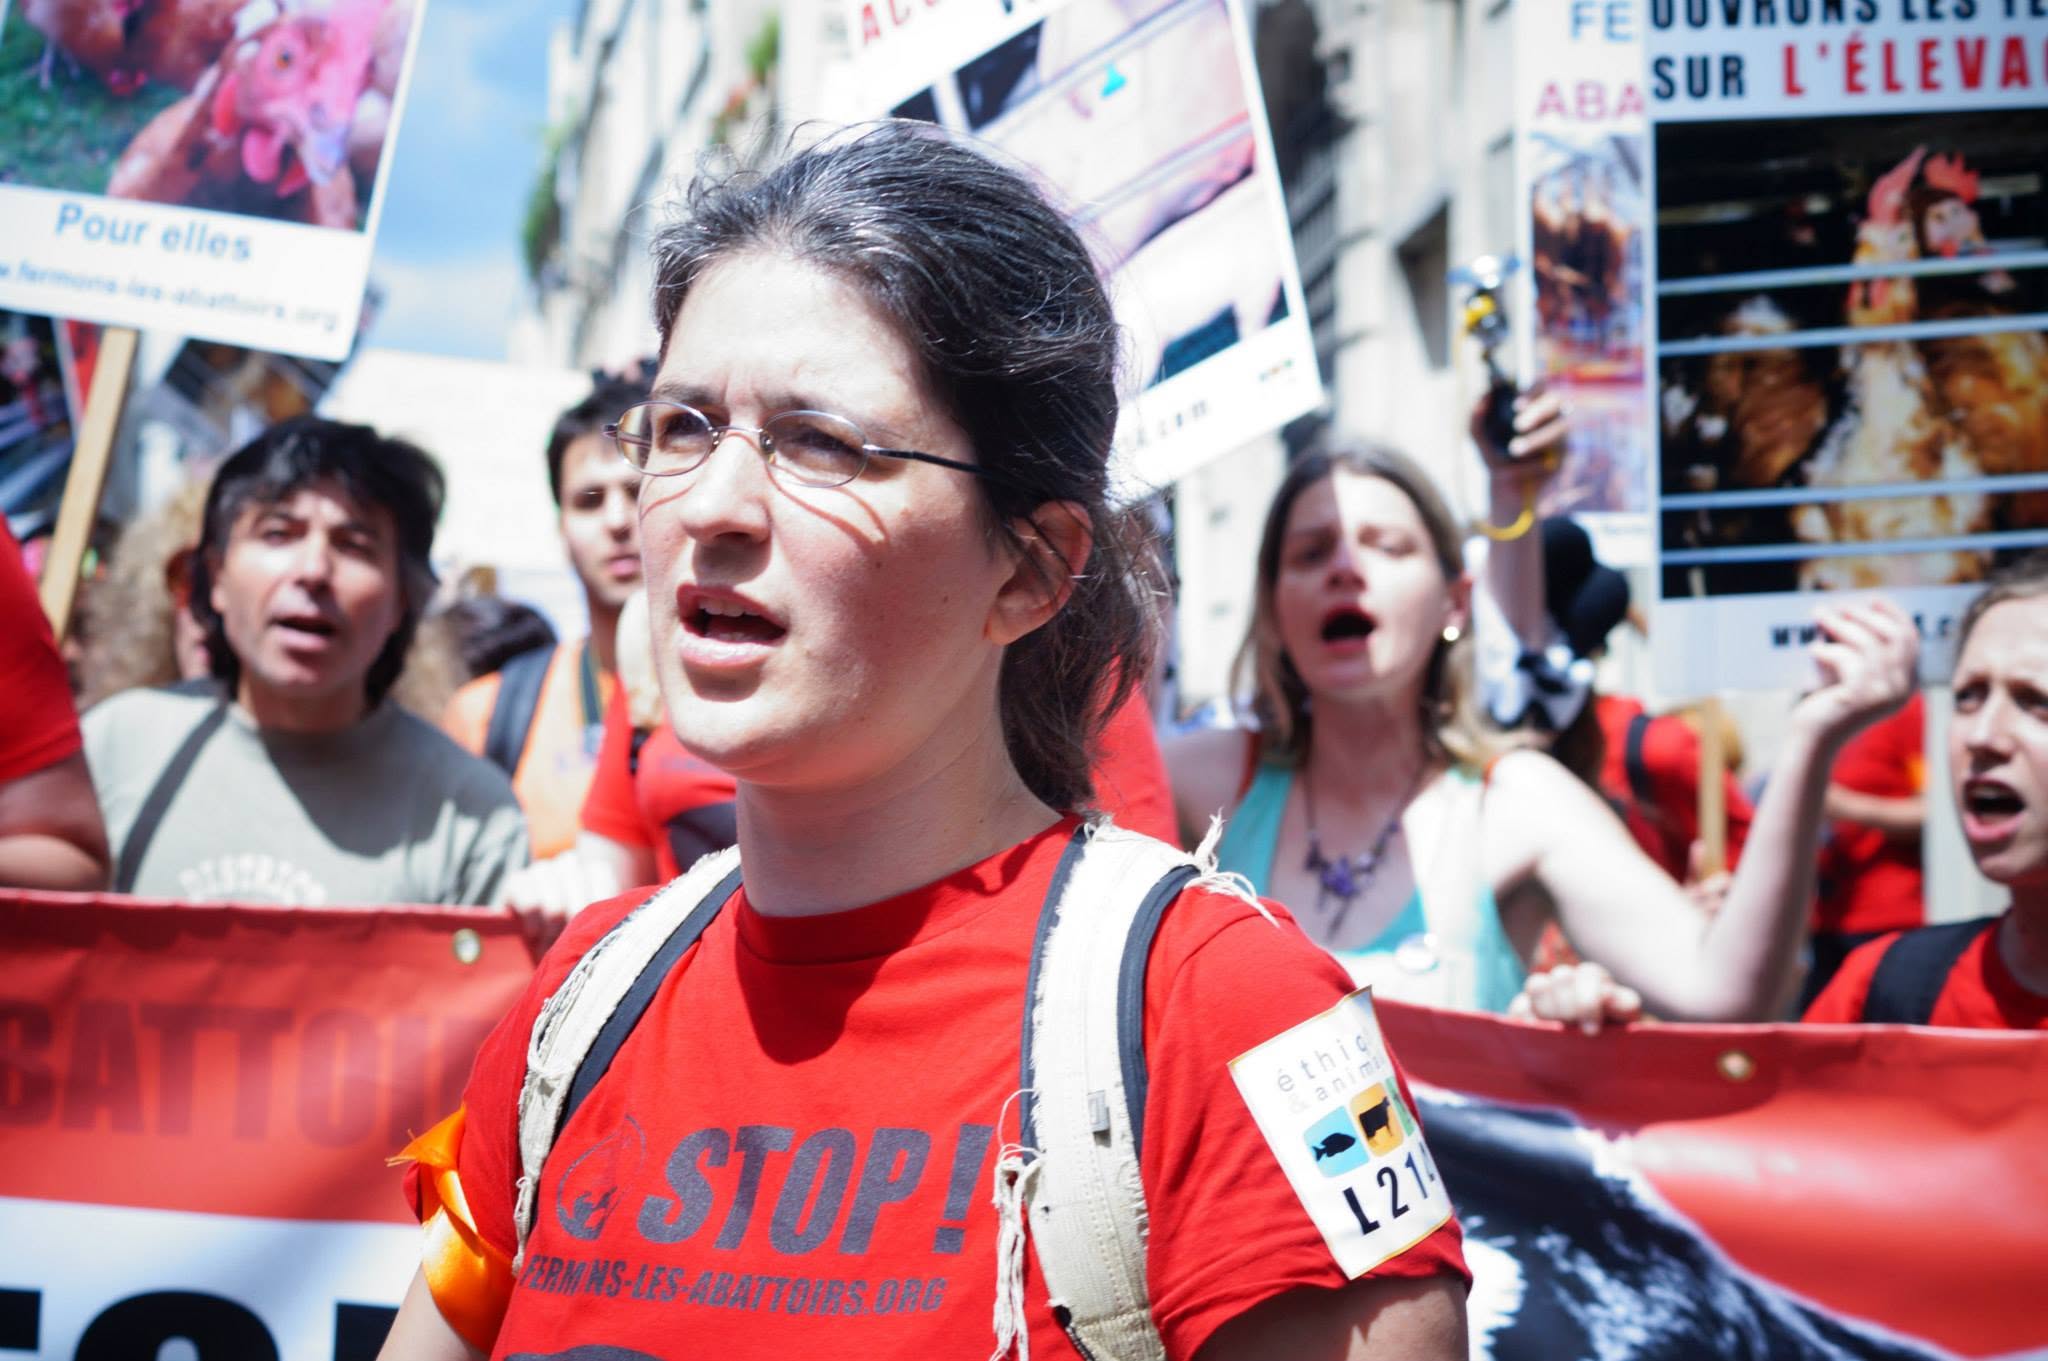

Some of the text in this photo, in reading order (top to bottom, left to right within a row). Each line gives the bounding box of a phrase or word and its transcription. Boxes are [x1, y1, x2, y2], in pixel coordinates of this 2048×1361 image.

[1653, 28, 2048, 100] SUR L'ÉLEVA
[55, 201, 252, 260] Pour elles
[636, 1125, 932, 1255] STOP
